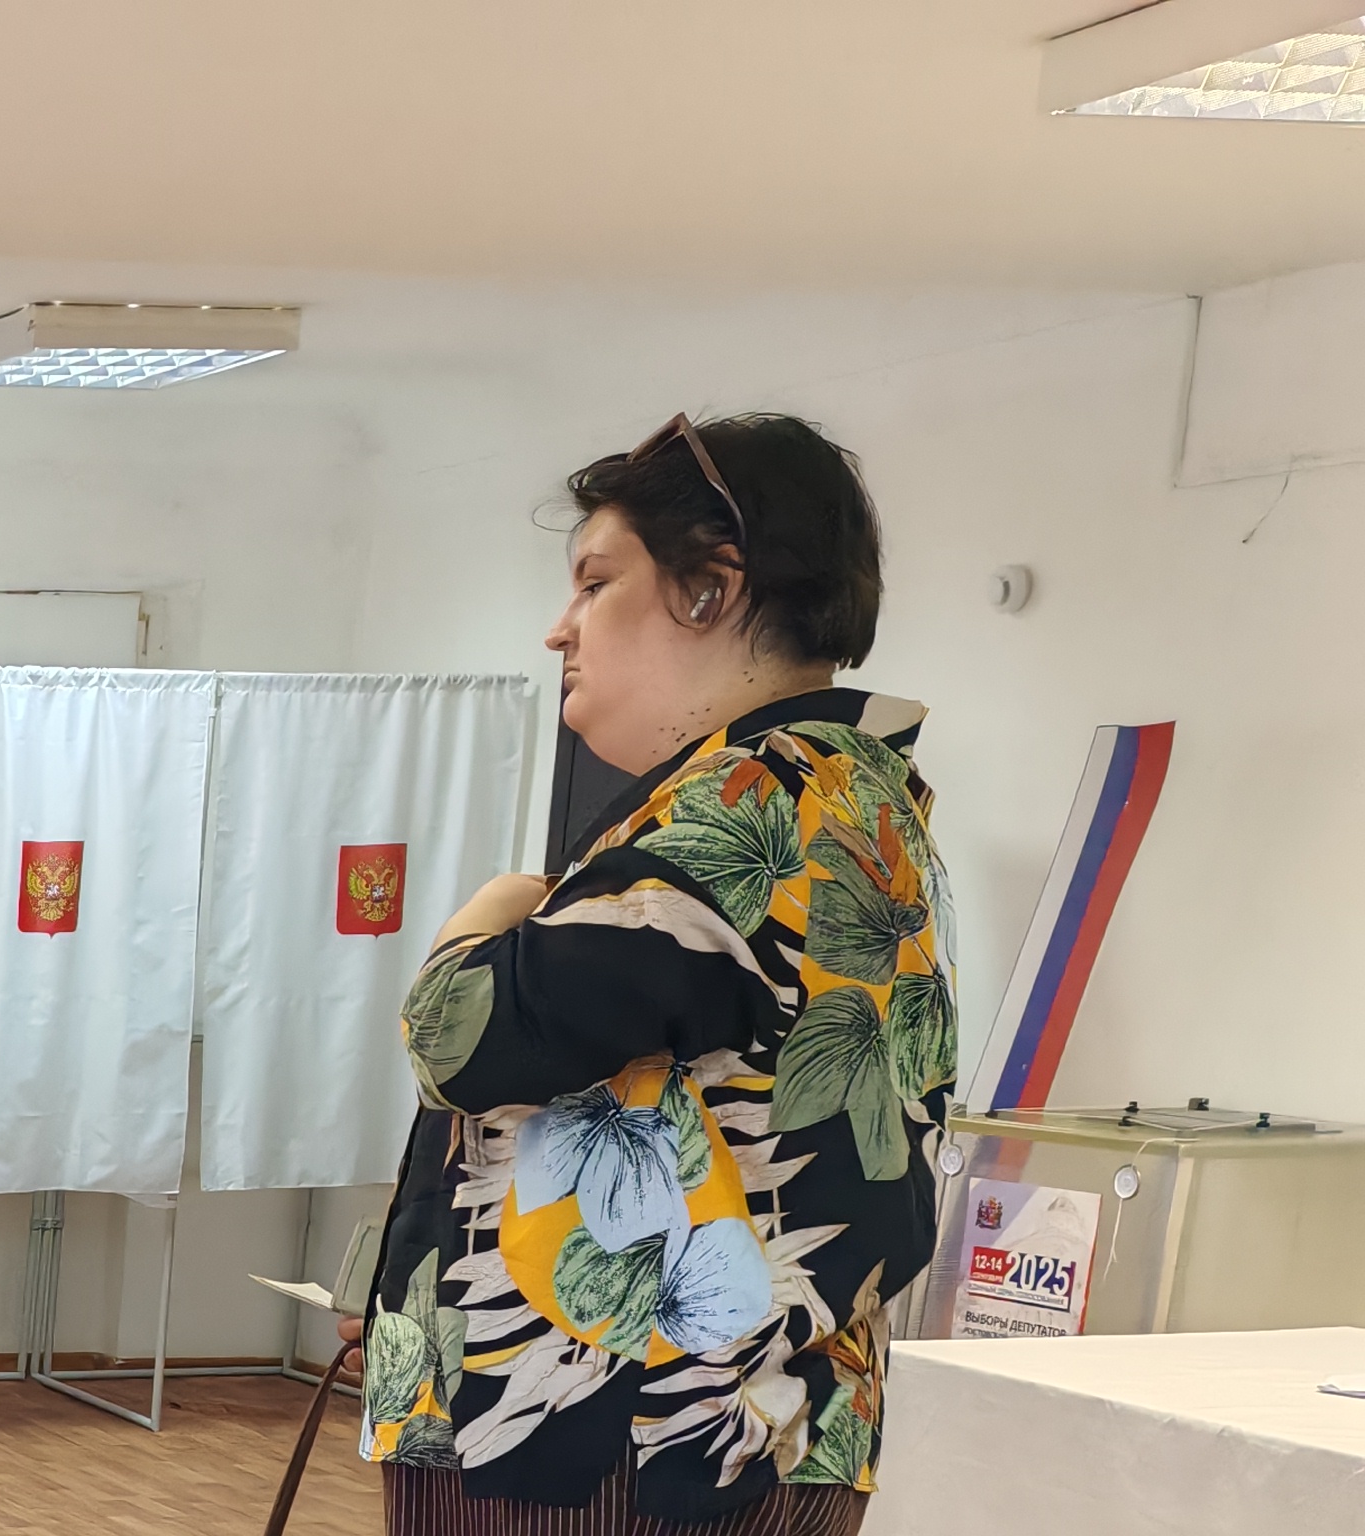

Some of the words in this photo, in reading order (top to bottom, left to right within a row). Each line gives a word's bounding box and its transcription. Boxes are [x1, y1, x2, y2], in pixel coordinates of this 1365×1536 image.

[974, 1254, 1003, 1271] 12-14
[1003, 1250, 1071, 1297] 2025
[965, 1310, 1009, 1329] ВЫБОРЫ
[1009, 1319, 1068, 1338] ДЕПУТАТОВ
